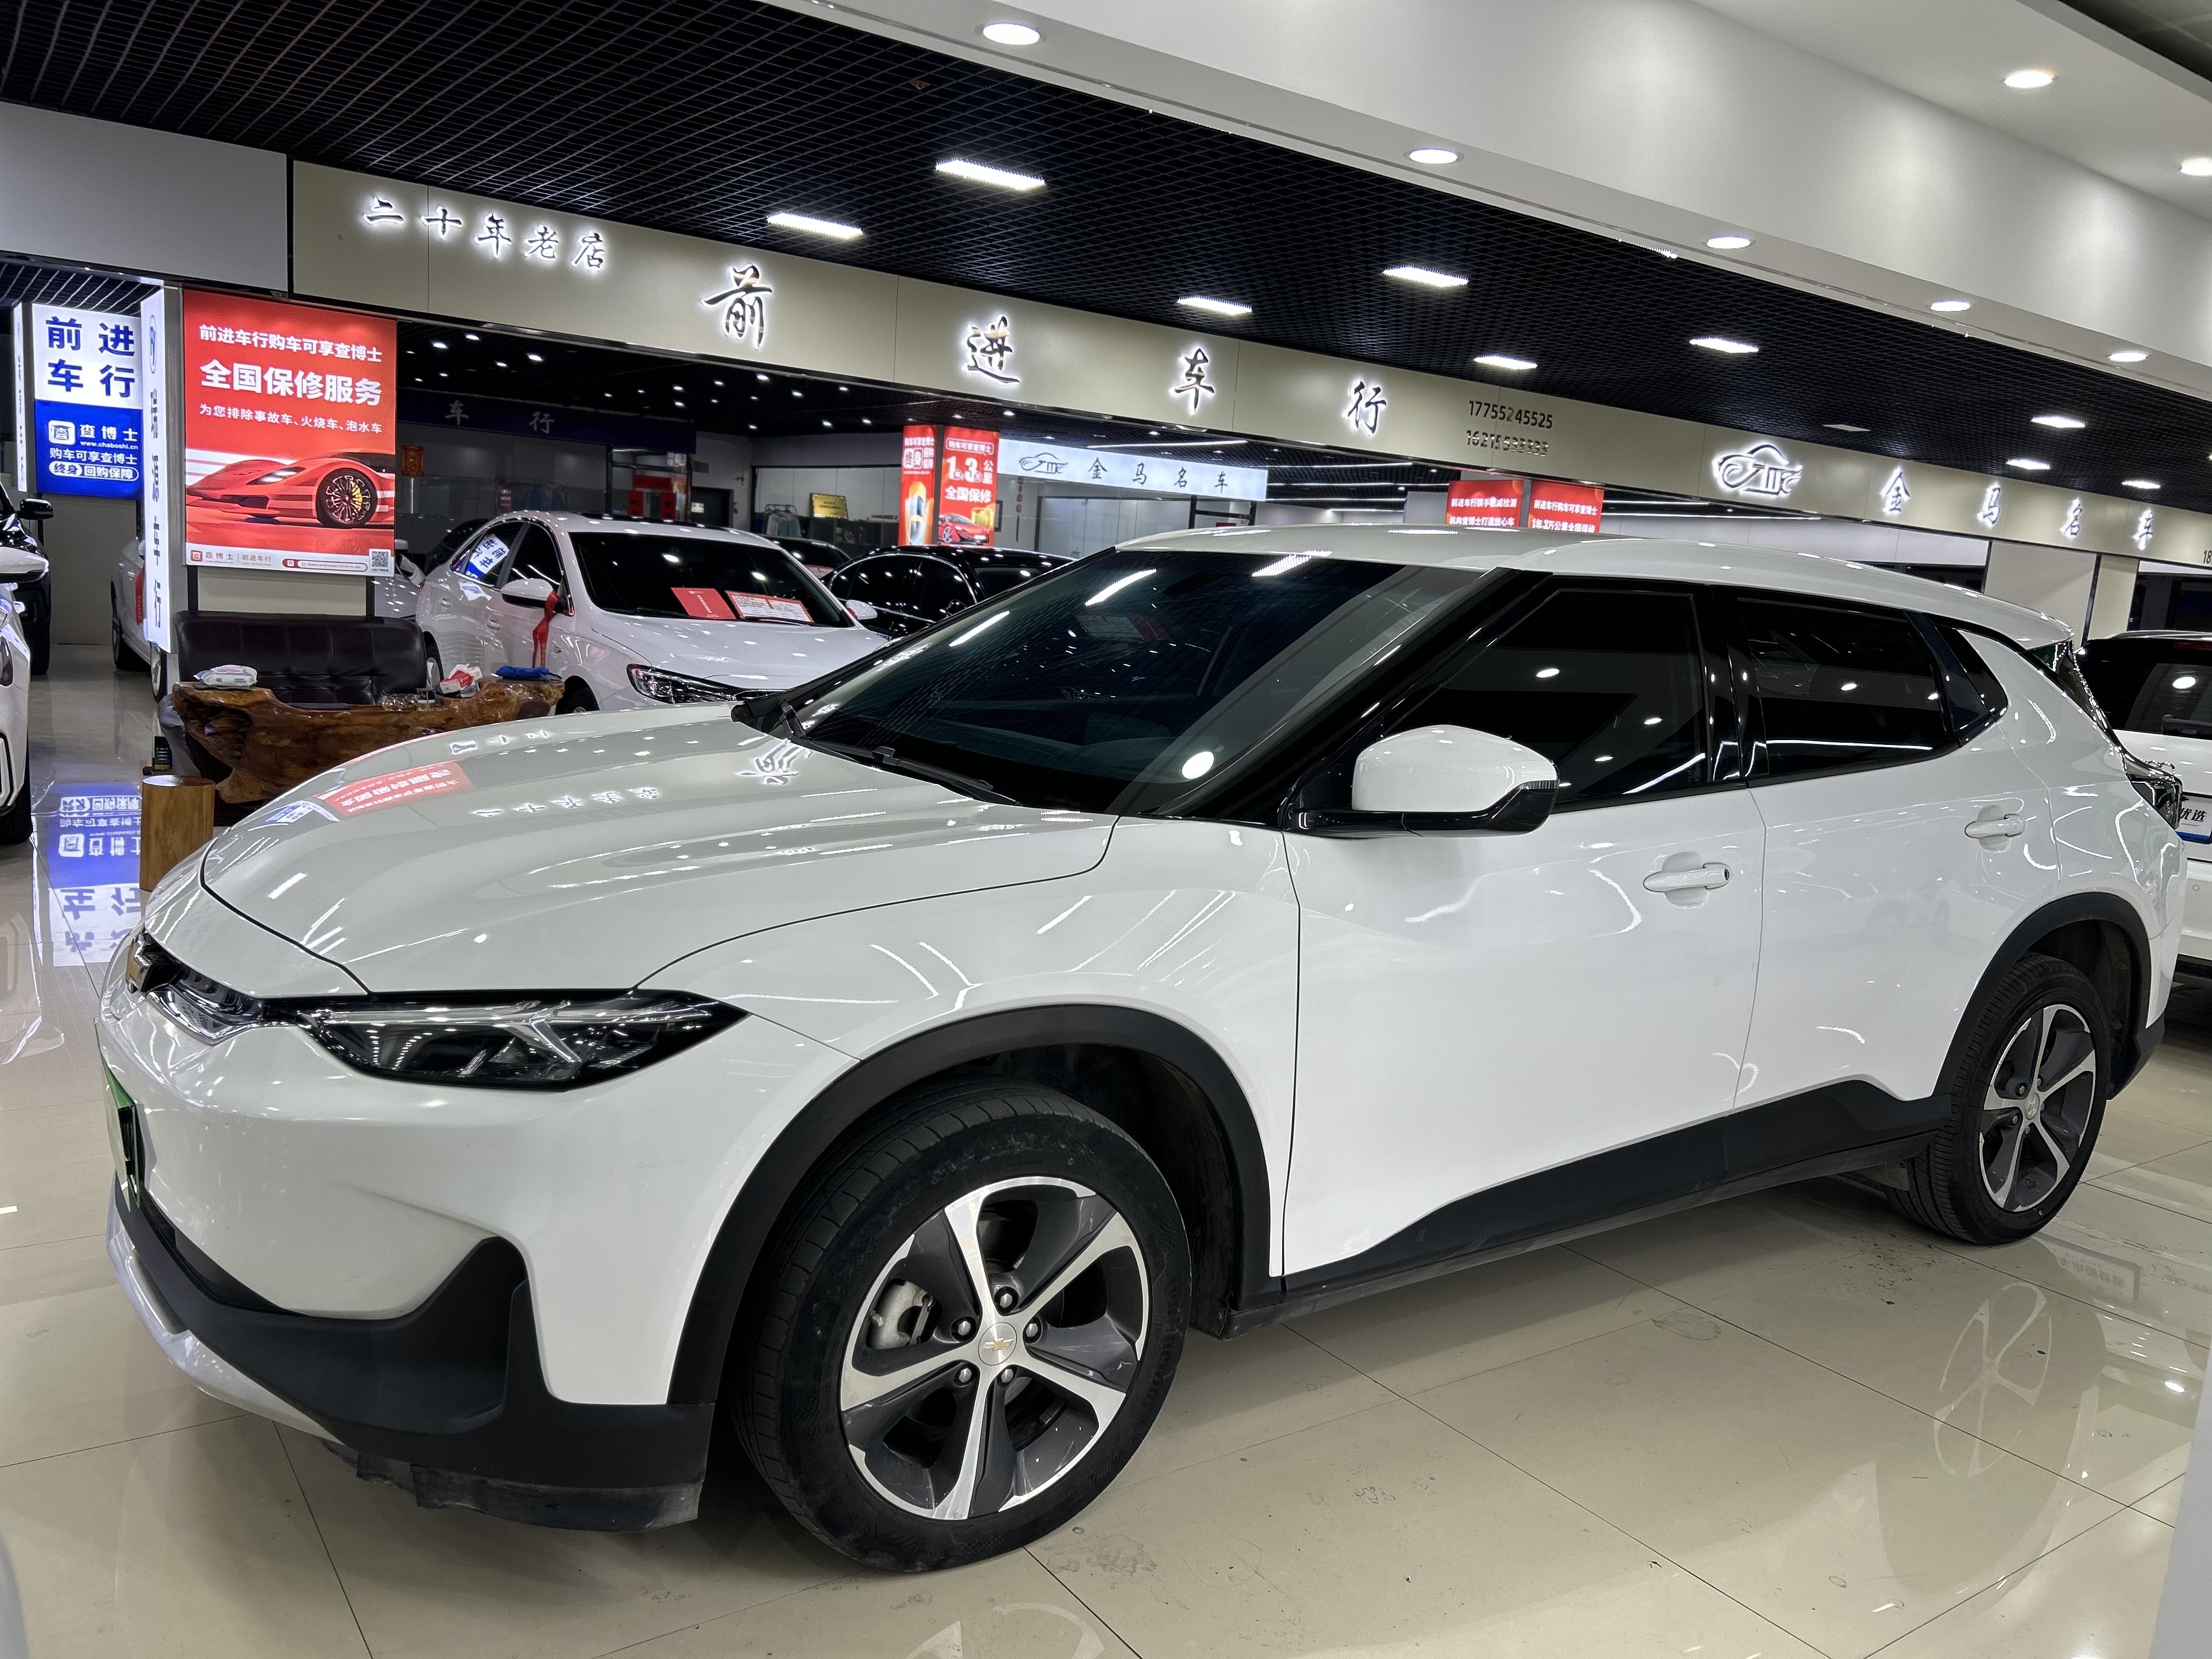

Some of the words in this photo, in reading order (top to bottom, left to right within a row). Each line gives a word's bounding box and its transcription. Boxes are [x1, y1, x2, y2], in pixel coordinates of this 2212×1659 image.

[364, 196, 605, 270] 二十年老店
[46, 317, 135, 357] 前进
[199, 324, 383, 363] 前进车行购车可享查博士
[702, 264, 1387, 436] 前进车行
[48, 359, 135, 398] 车行
[199, 359, 383, 406] 全国保修服务
[199, 403, 383, 434] 为您排除事故车、火烧车、泡水车
[1469, 400, 1553, 429] 17755245525
[80, 424, 138, 442] 查博士
[80, 441, 139, 450] www.chaboshi.cn
[50, 447, 138, 465] 购车可享查博士
[84, 466, 133, 479] 回购保障
[1088, 457, 1228, 493] 金马名车
[945, 486, 992, 504] 全国保修
[1880, 466, 2154, 550] 金马名车
[2203, 550, 2212, 564] 18
